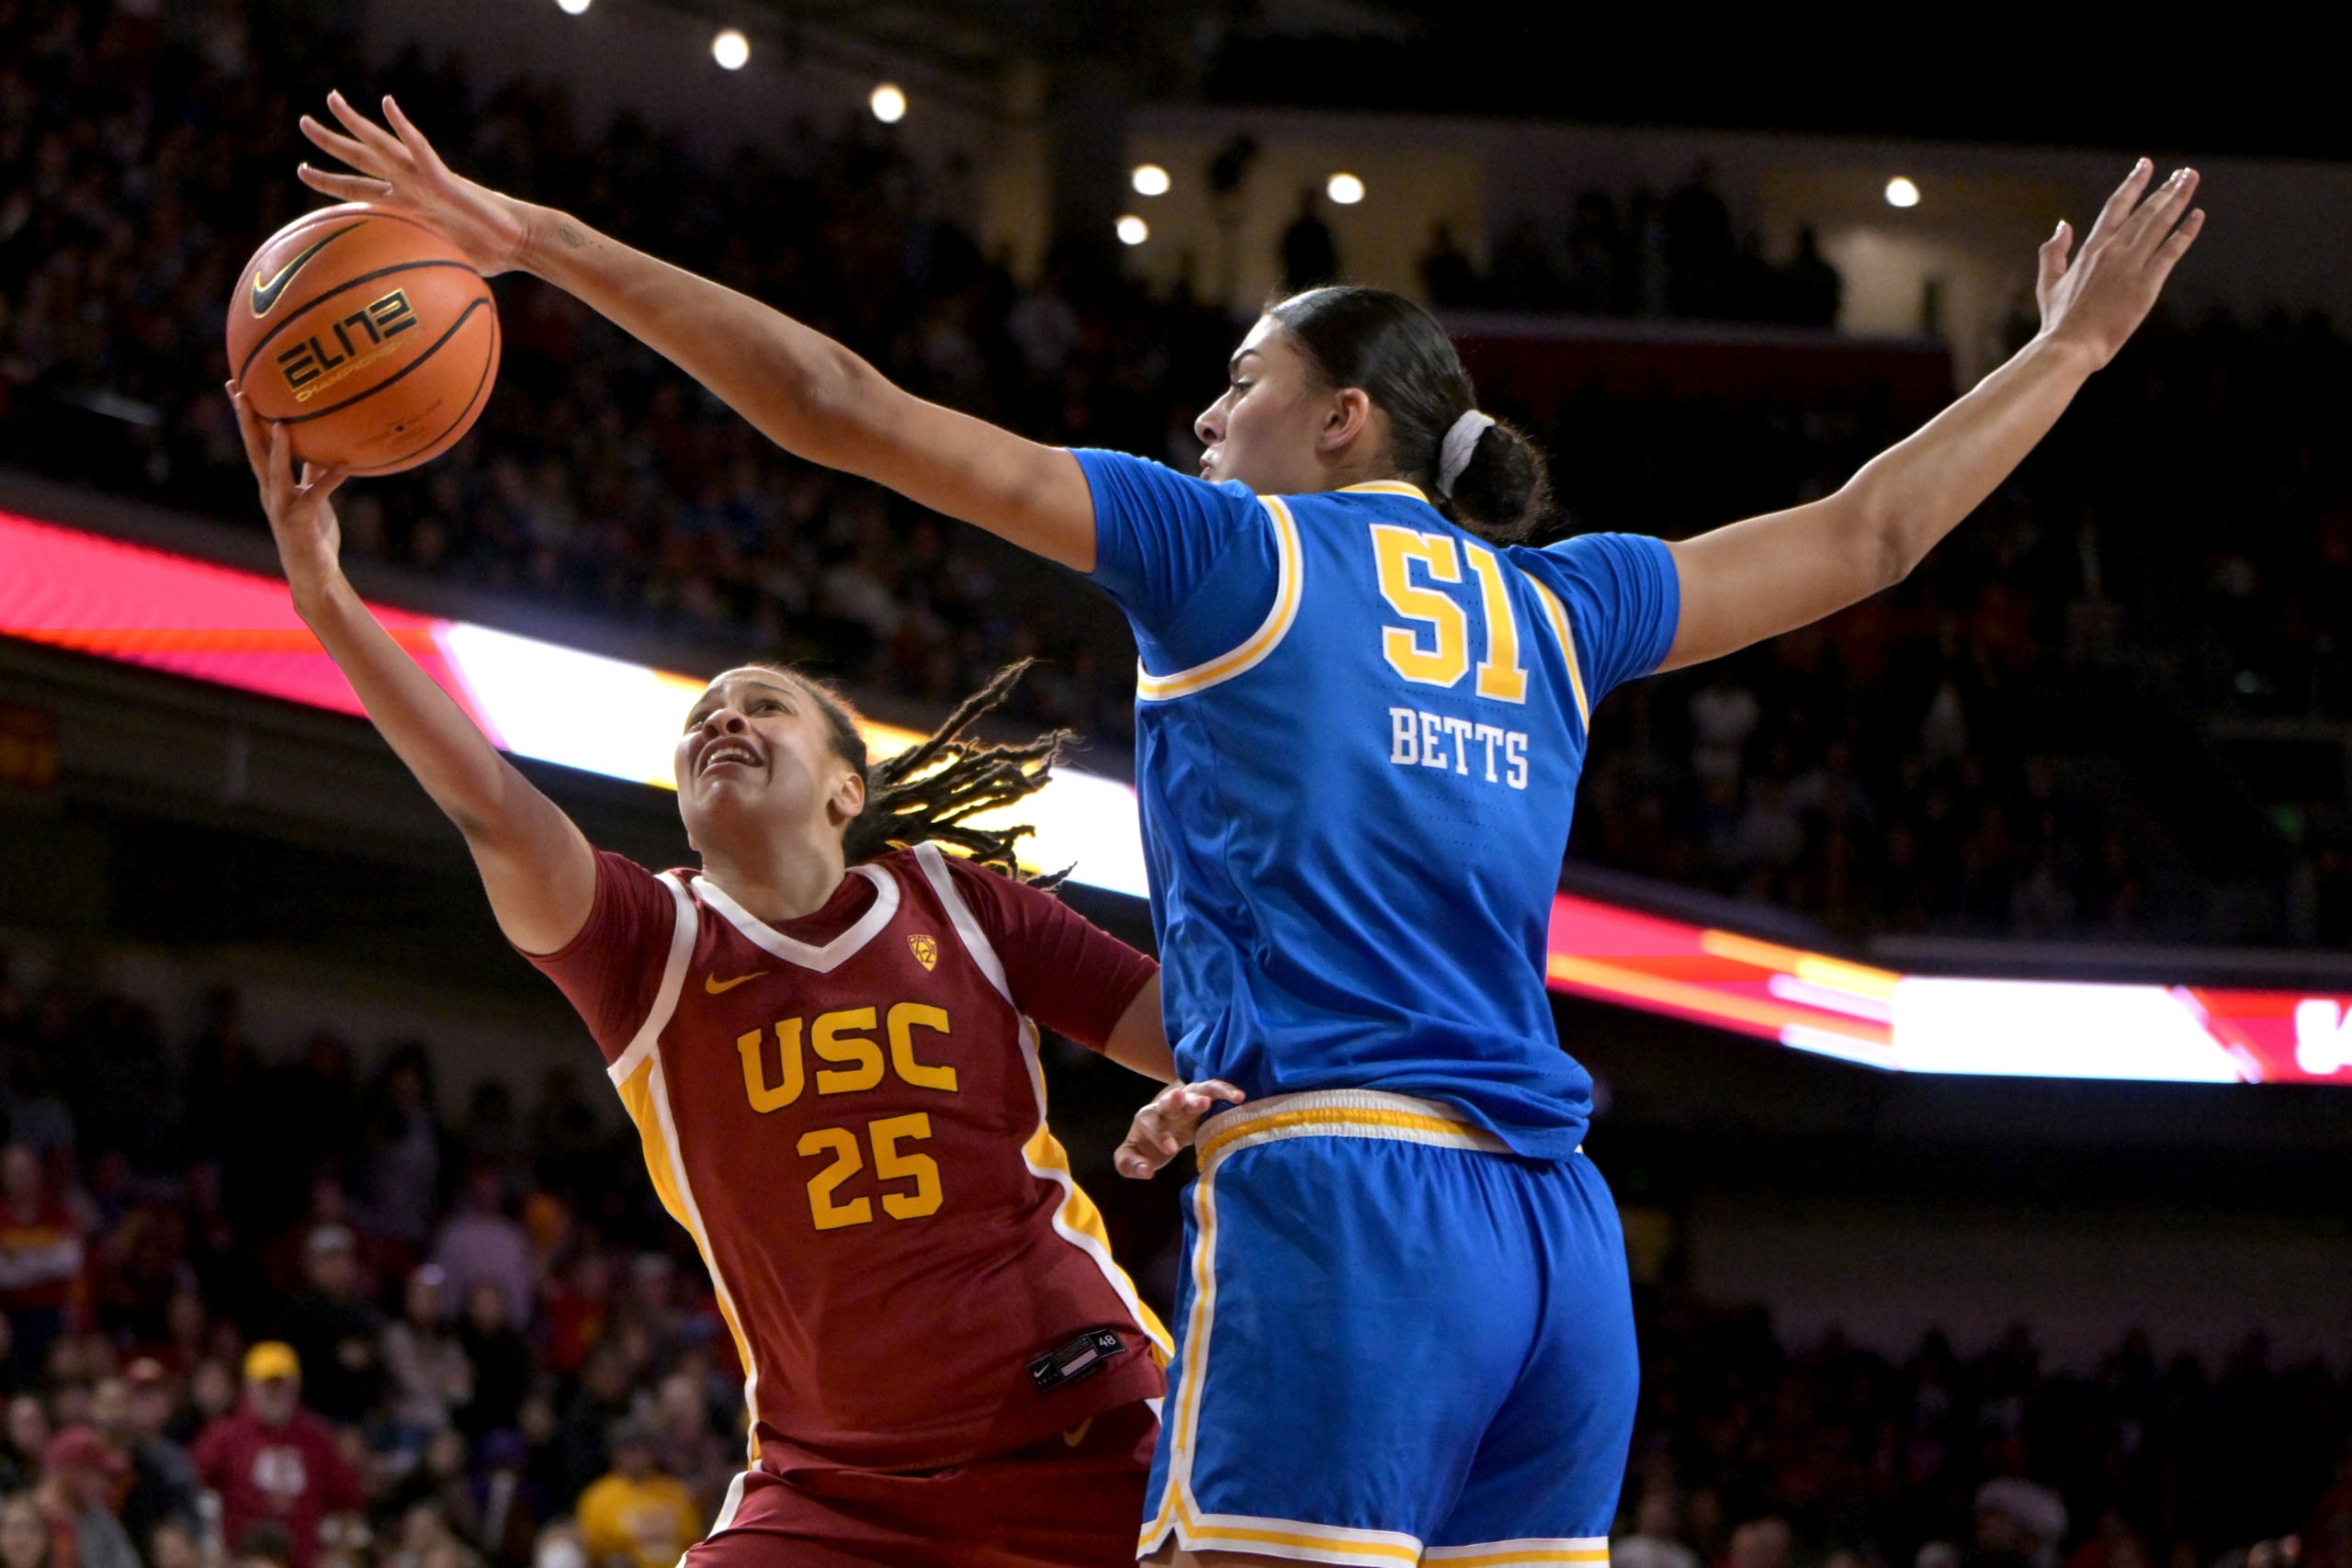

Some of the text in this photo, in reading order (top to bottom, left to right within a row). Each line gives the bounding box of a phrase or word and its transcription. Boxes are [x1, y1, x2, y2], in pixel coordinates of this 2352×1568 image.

[277, 288, 419, 389] ELITE
[1369, 524, 1529, 705] 51
[1389, 707, 1528, 790] BETTS
[918, 949, 934, 964] 12
[737, 1002, 958, 1113] USC
[797, 1111, 944, 1230] 25
[1099, 1335, 1116, 1348] 48
